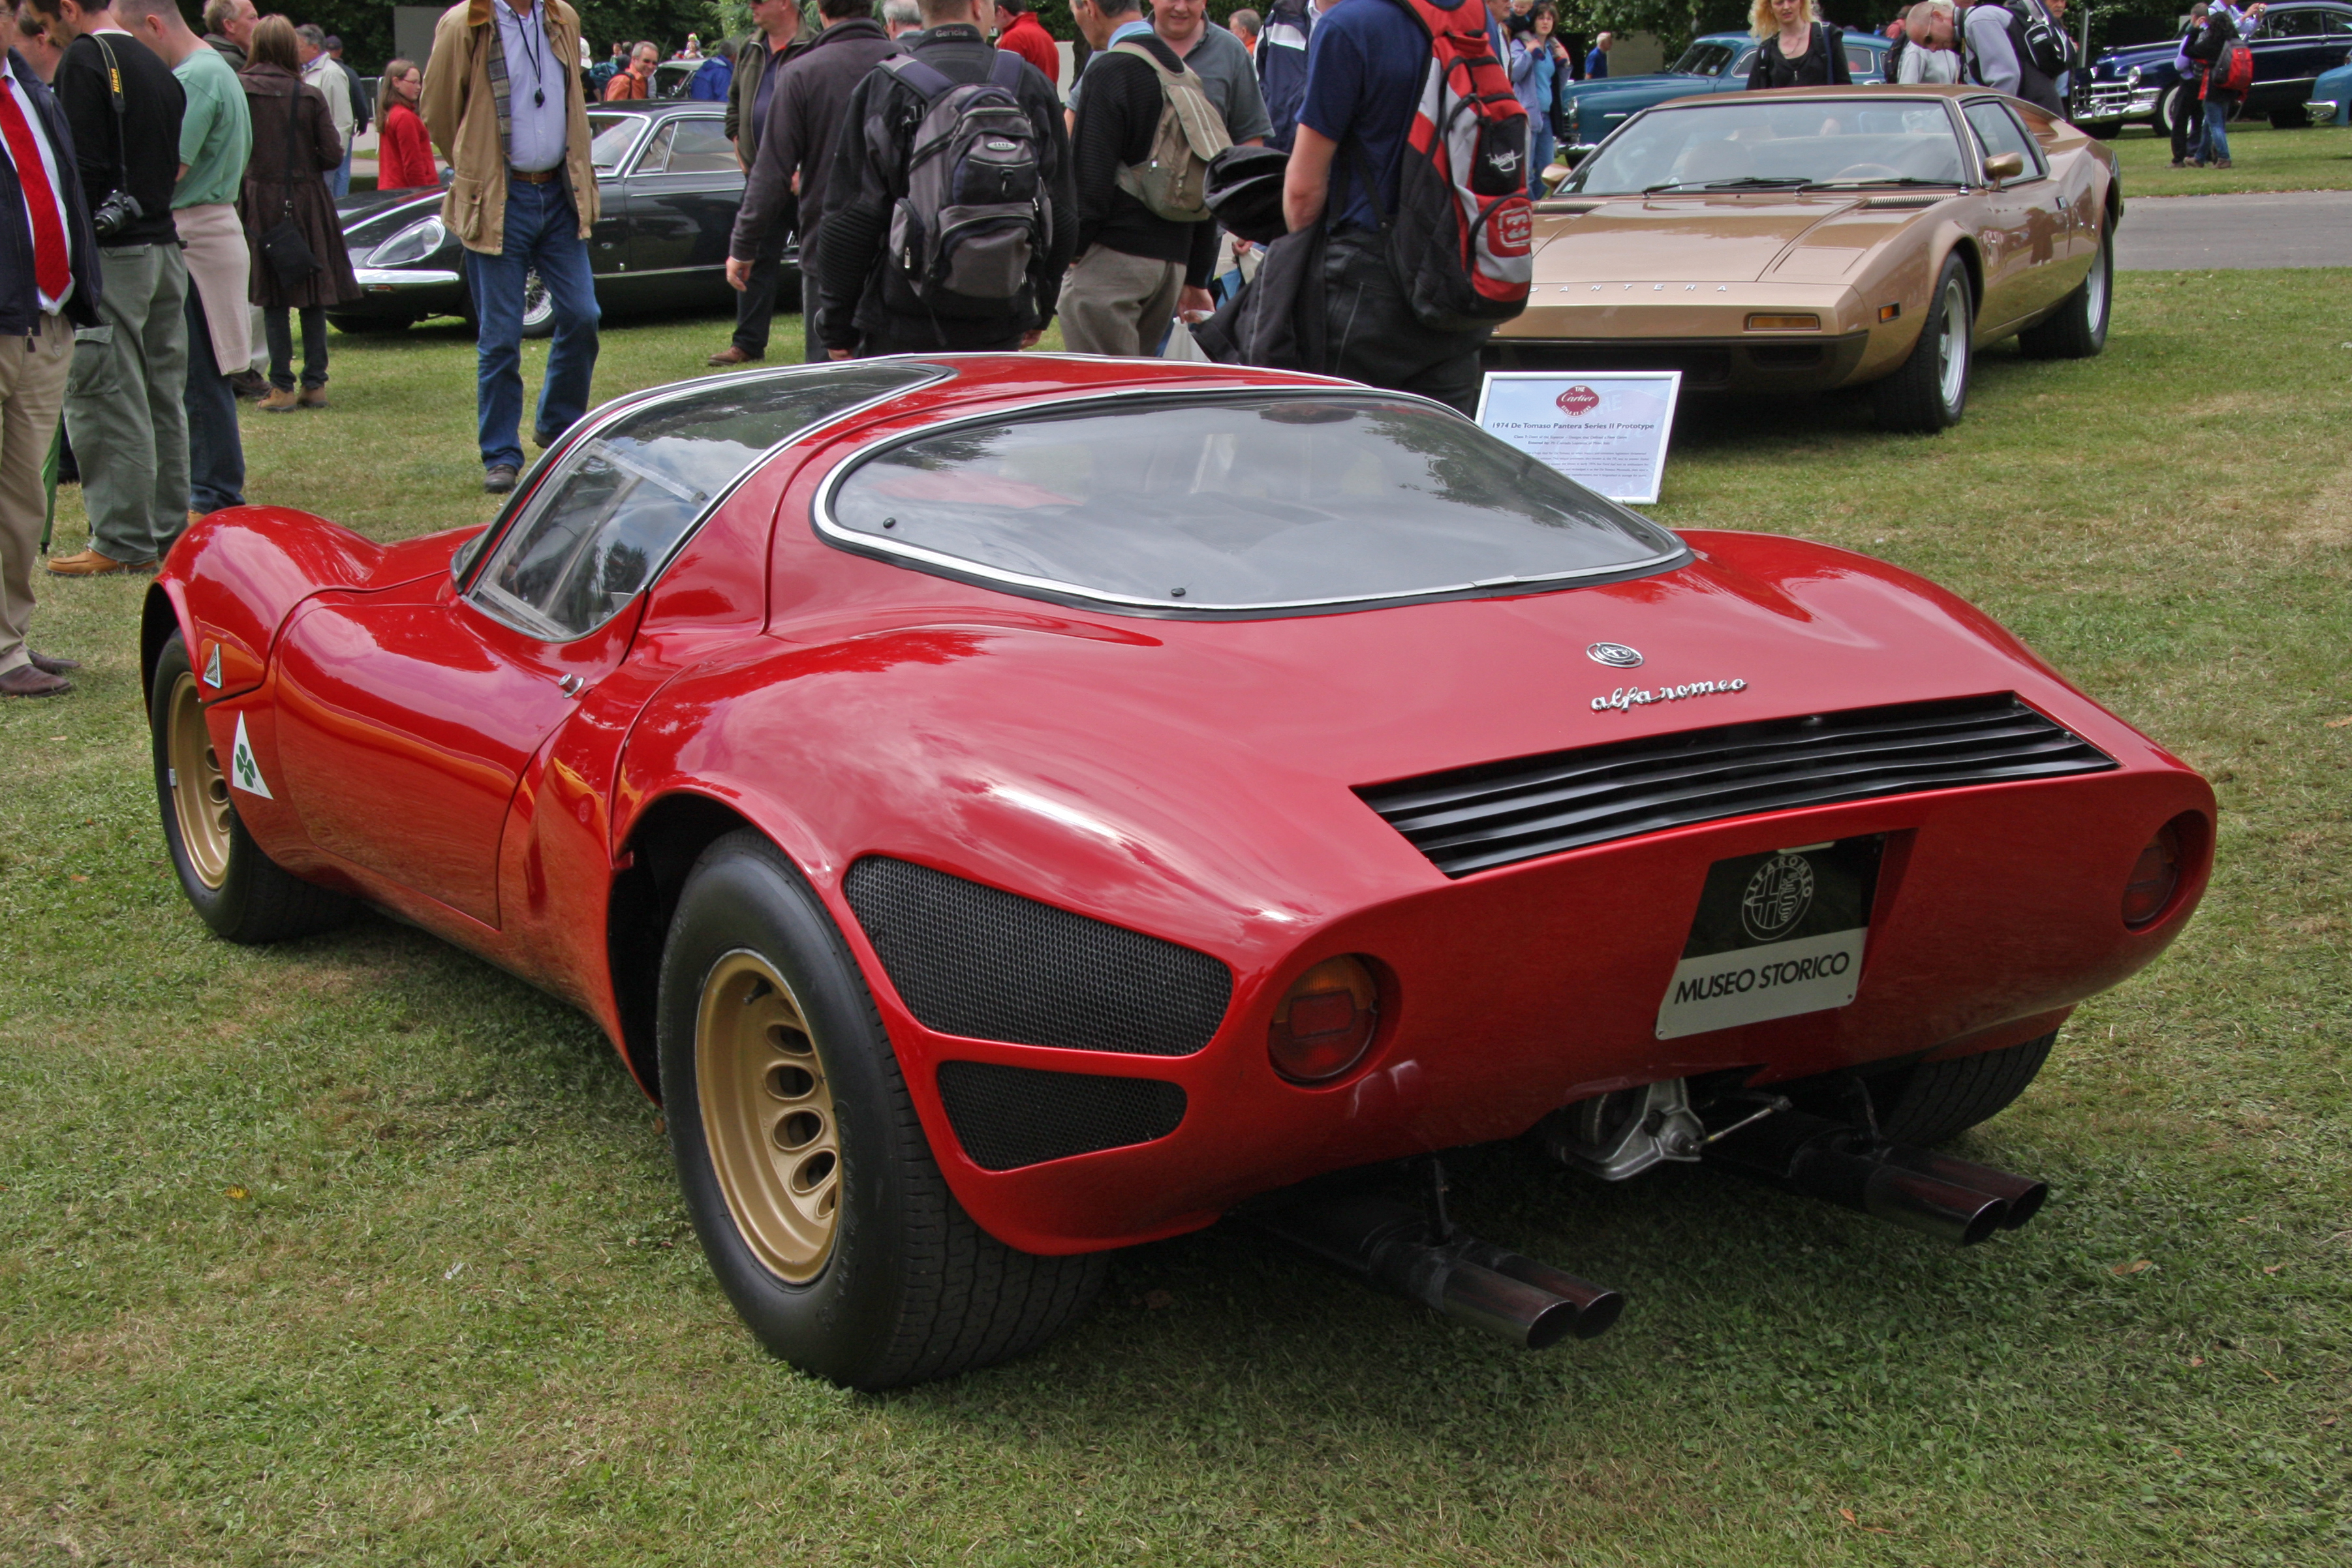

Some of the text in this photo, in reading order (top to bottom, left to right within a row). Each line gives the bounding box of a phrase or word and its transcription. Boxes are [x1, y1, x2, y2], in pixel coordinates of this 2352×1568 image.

[110, 68, 120, 93] Nikon
[1529, 283, 1727, 293] PANTERA
[1561, 392, 1595, 402] Cartier
[1590, 679, 1748, 712] alfa romeo
[1674, 951, 1849, 1004] MUSEO STORICO
